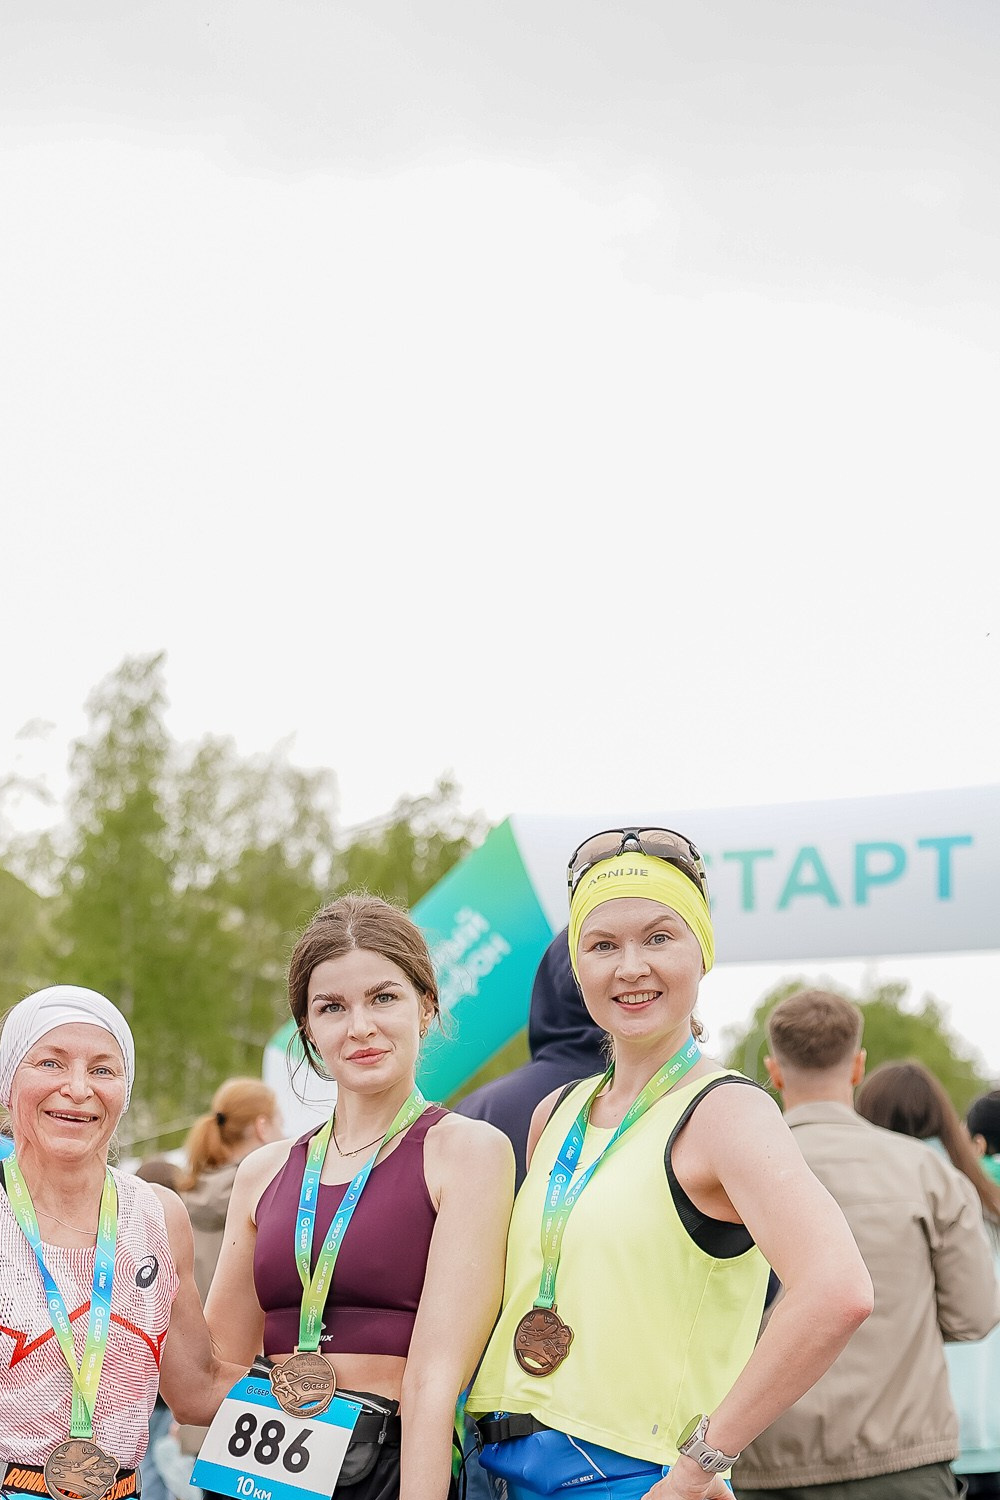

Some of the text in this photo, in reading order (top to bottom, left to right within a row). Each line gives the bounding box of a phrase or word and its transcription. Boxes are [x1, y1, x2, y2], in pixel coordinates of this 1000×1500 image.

[704, 835, 974, 914] ТАРТ
[669, 1062, 682, 1076] 185
[550, 1184, 561, 1207] СБЕР
[331, 1217, 344, 1239] СБЕР
[55, 1310, 69, 1334] СБЕР
[93, 1318, 103, 1343] СБЕР
[89, 1352, 97, 1369] 185
[253, 1387, 270, 1397] СБЕР
[227, 1412, 314, 1474] 886
[579, 1474, 595, 1483] BELT
